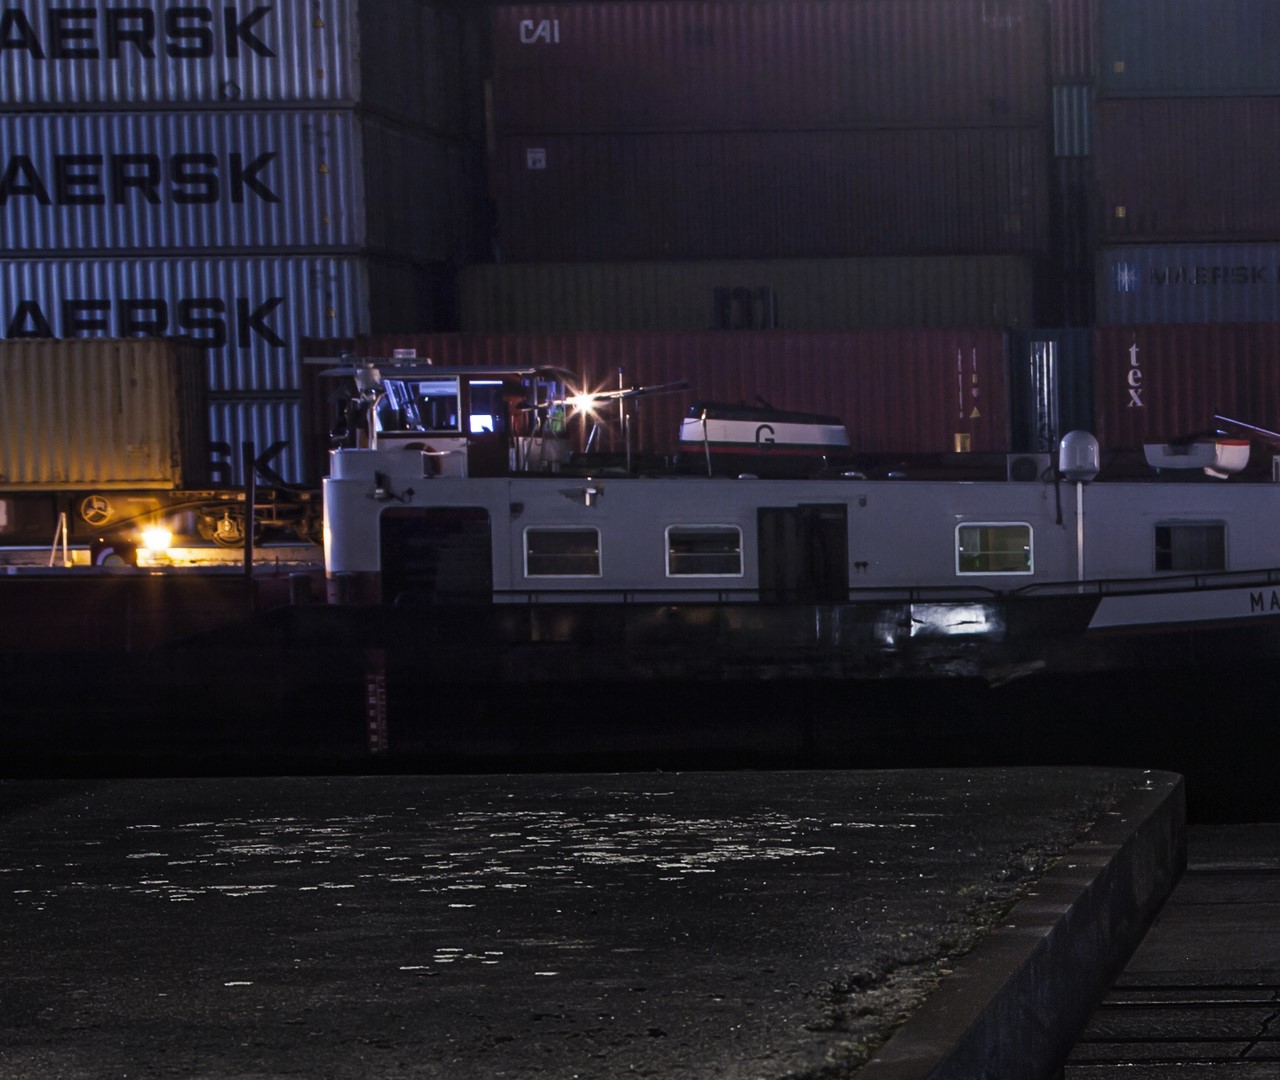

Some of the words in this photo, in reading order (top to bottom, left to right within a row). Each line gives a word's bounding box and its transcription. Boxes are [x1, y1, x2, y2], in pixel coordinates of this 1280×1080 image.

[0, 6, 277, 59] AERSK
[519, 19, 560, 44] CAI
[0, 152, 281, 206] AERSK
[8, 297, 287, 348] AERSK
[1126, 342, 1144, 407] tex
